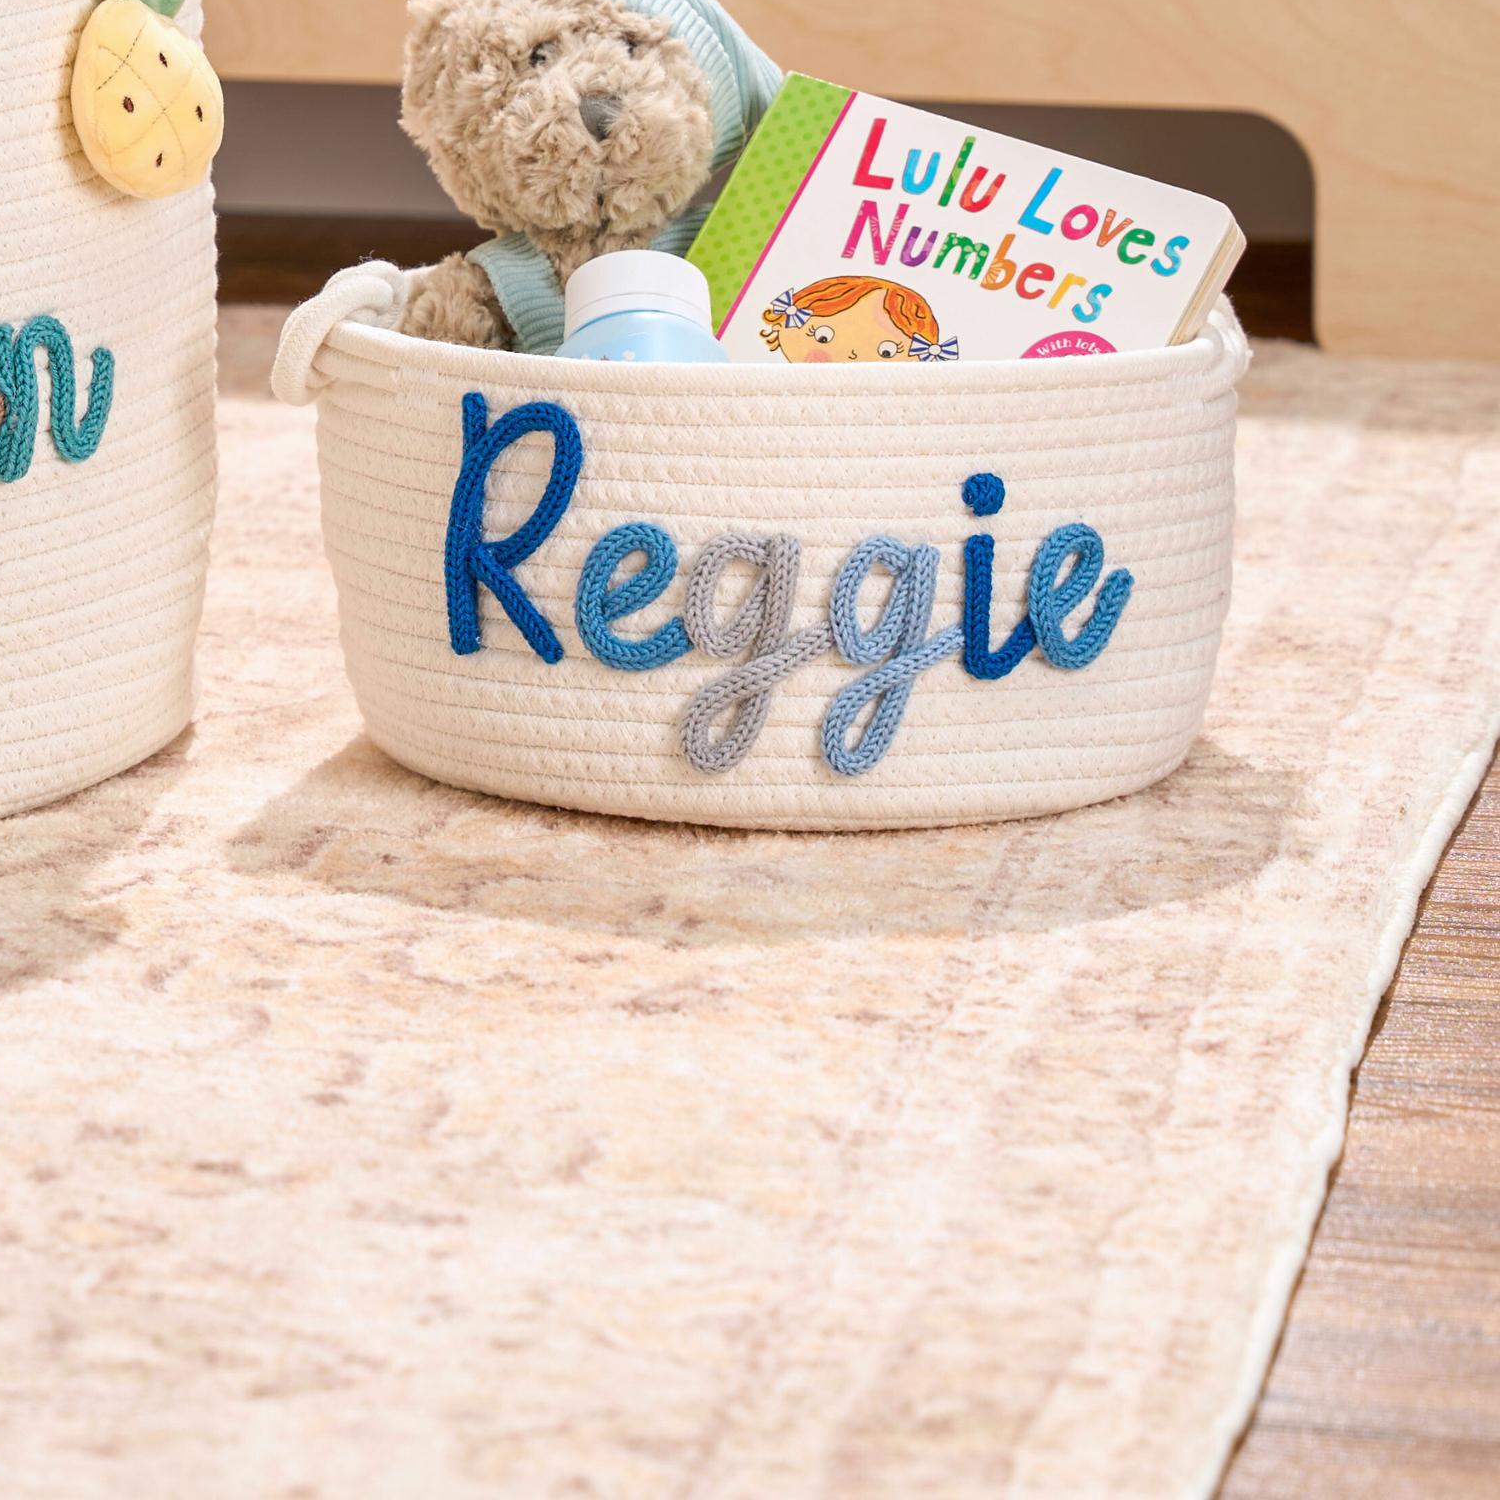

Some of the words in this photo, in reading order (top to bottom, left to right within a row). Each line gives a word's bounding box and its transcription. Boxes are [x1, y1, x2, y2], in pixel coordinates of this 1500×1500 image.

[841, 200, 1112, 324] Numbers
[852, 118, 1007, 213] Lulu
[1018, 167, 1190, 277] Loves
[1036, 338, 1072, 356] With
[1075, 338, 1100, 355] lots
[444, 392, 1135, 776] Reggie
